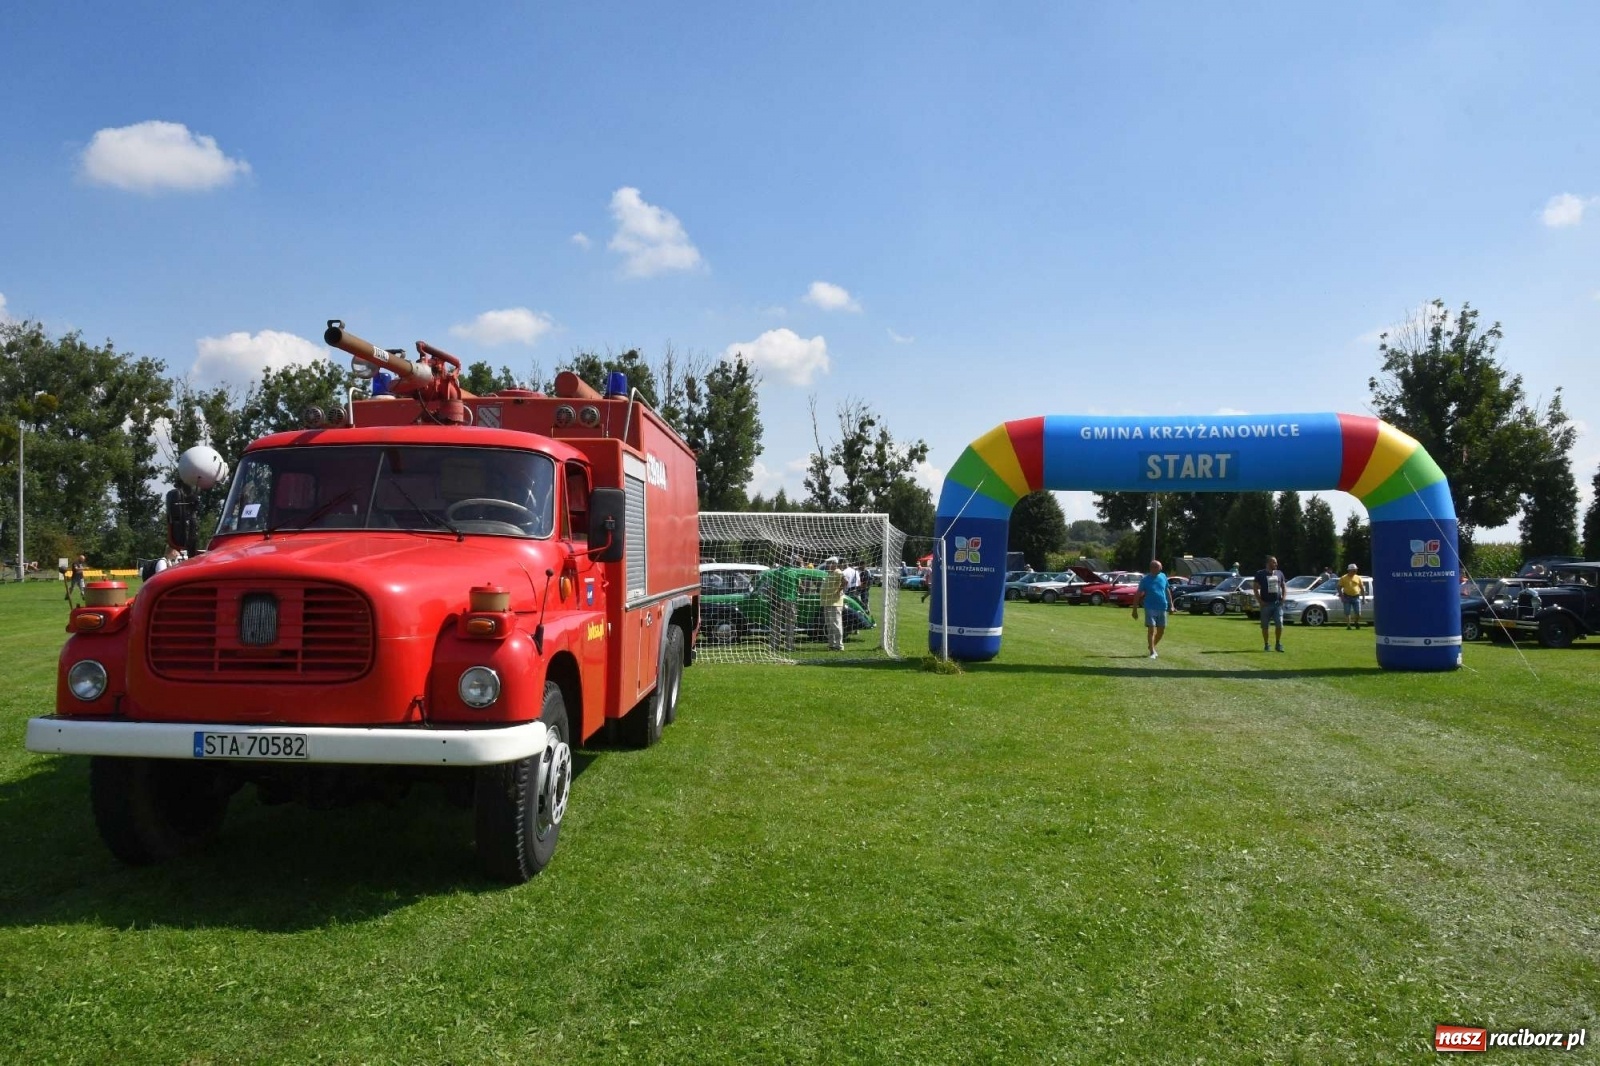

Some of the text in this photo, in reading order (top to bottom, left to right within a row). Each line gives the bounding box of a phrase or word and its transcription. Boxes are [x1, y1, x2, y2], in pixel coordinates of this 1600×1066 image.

[1080, 423, 1300, 440] GMINA KRZYŻANOWICE
[1146, 453, 1231, 480] START
[205, 735, 305, 756] STA 70582
